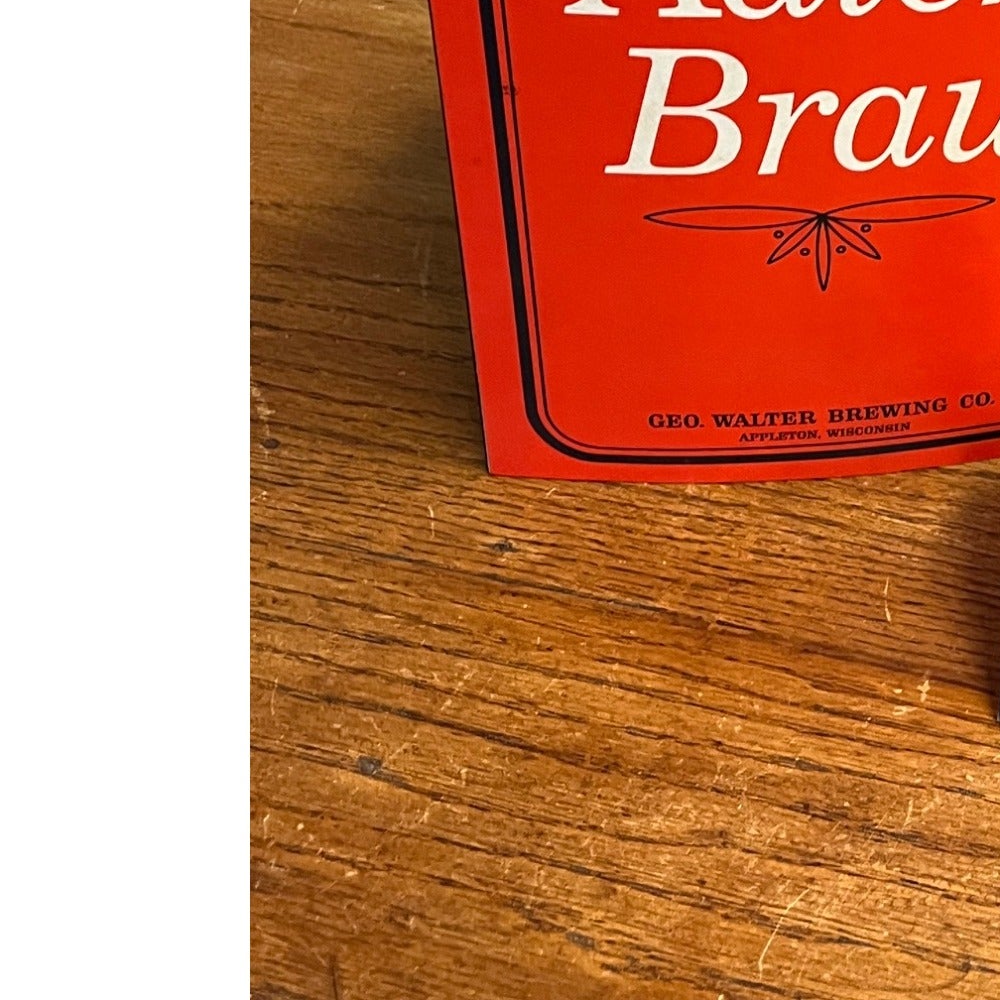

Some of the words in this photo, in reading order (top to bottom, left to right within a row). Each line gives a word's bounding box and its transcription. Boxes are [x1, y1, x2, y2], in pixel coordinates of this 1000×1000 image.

[648, 413, 704, 429] GEO.
[711, 410, 816, 428] WALTER
[828, 397, 948, 423] BREWING
[959, 391, 995, 409] CO.
[827, 421, 911, 438] WISCONSIN
